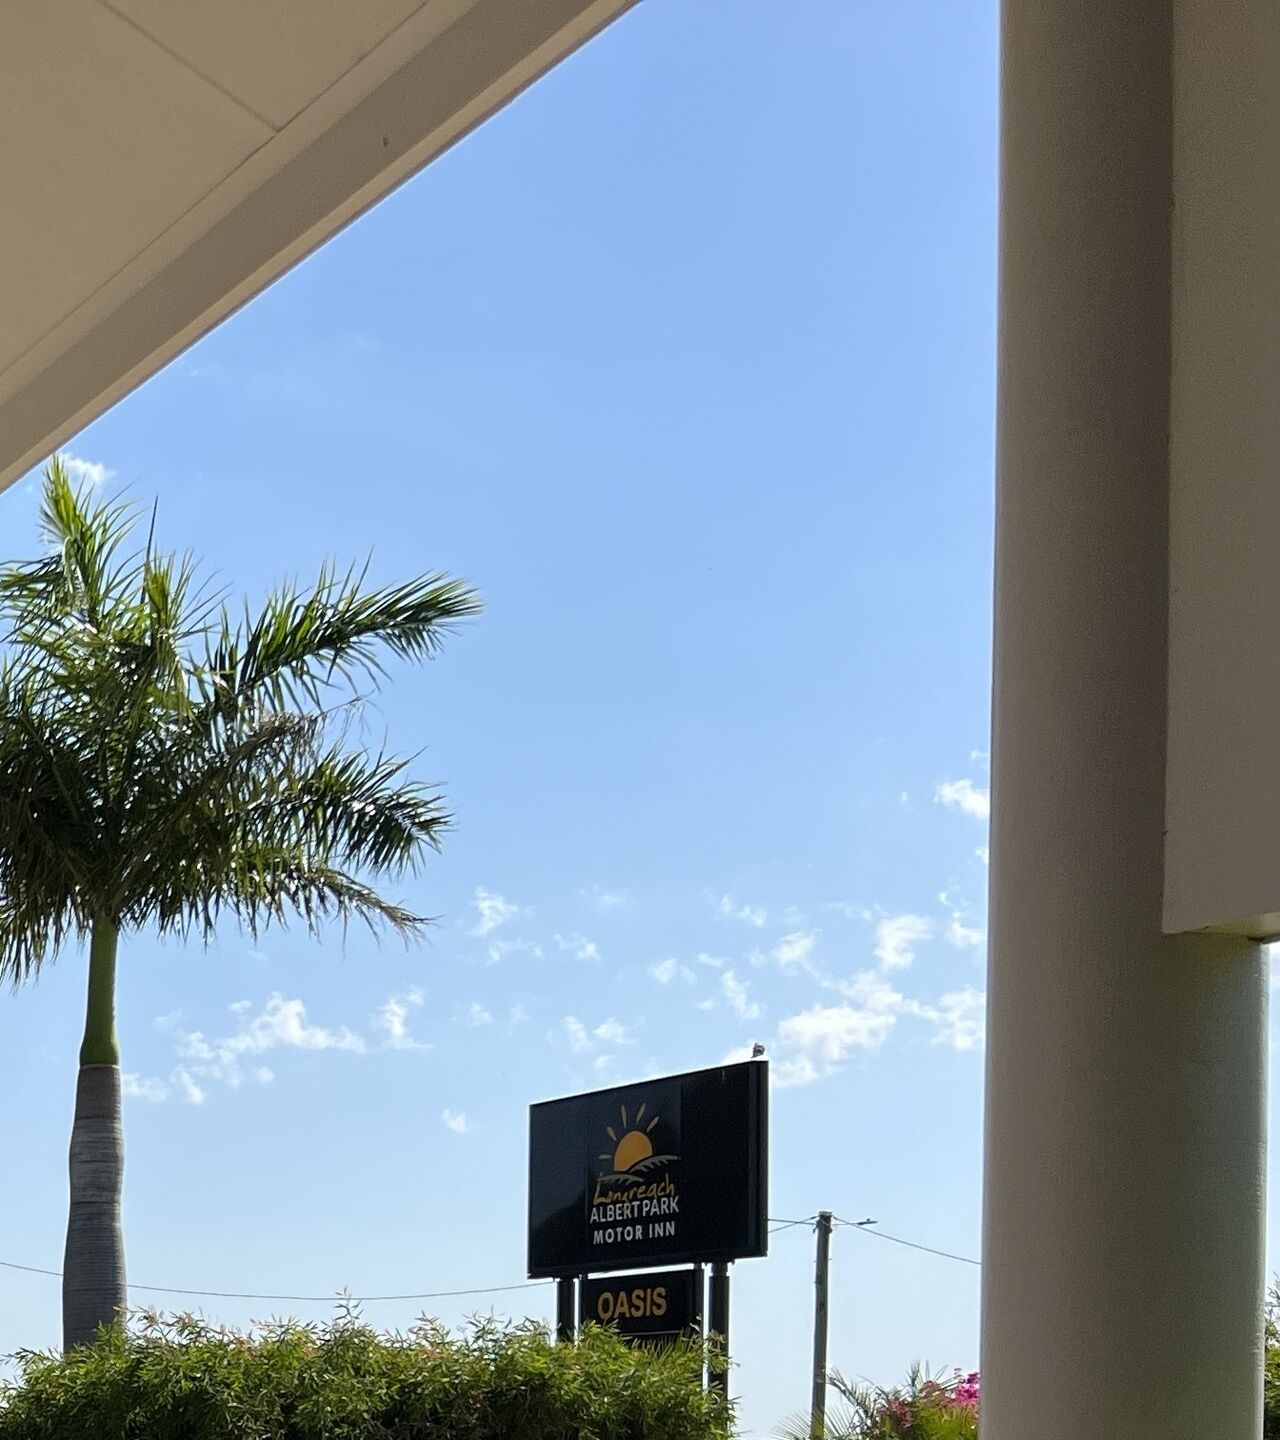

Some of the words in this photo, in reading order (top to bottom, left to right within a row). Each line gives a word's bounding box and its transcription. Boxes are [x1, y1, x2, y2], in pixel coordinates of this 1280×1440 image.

[590, 1201, 640, 1224] ALBERT
[642, 1196, 679, 1217] PARK
[593, 1225, 643, 1245] MOTOR
[649, 1221, 675, 1238] INN
[597, 1287, 667, 1320] OASIS
